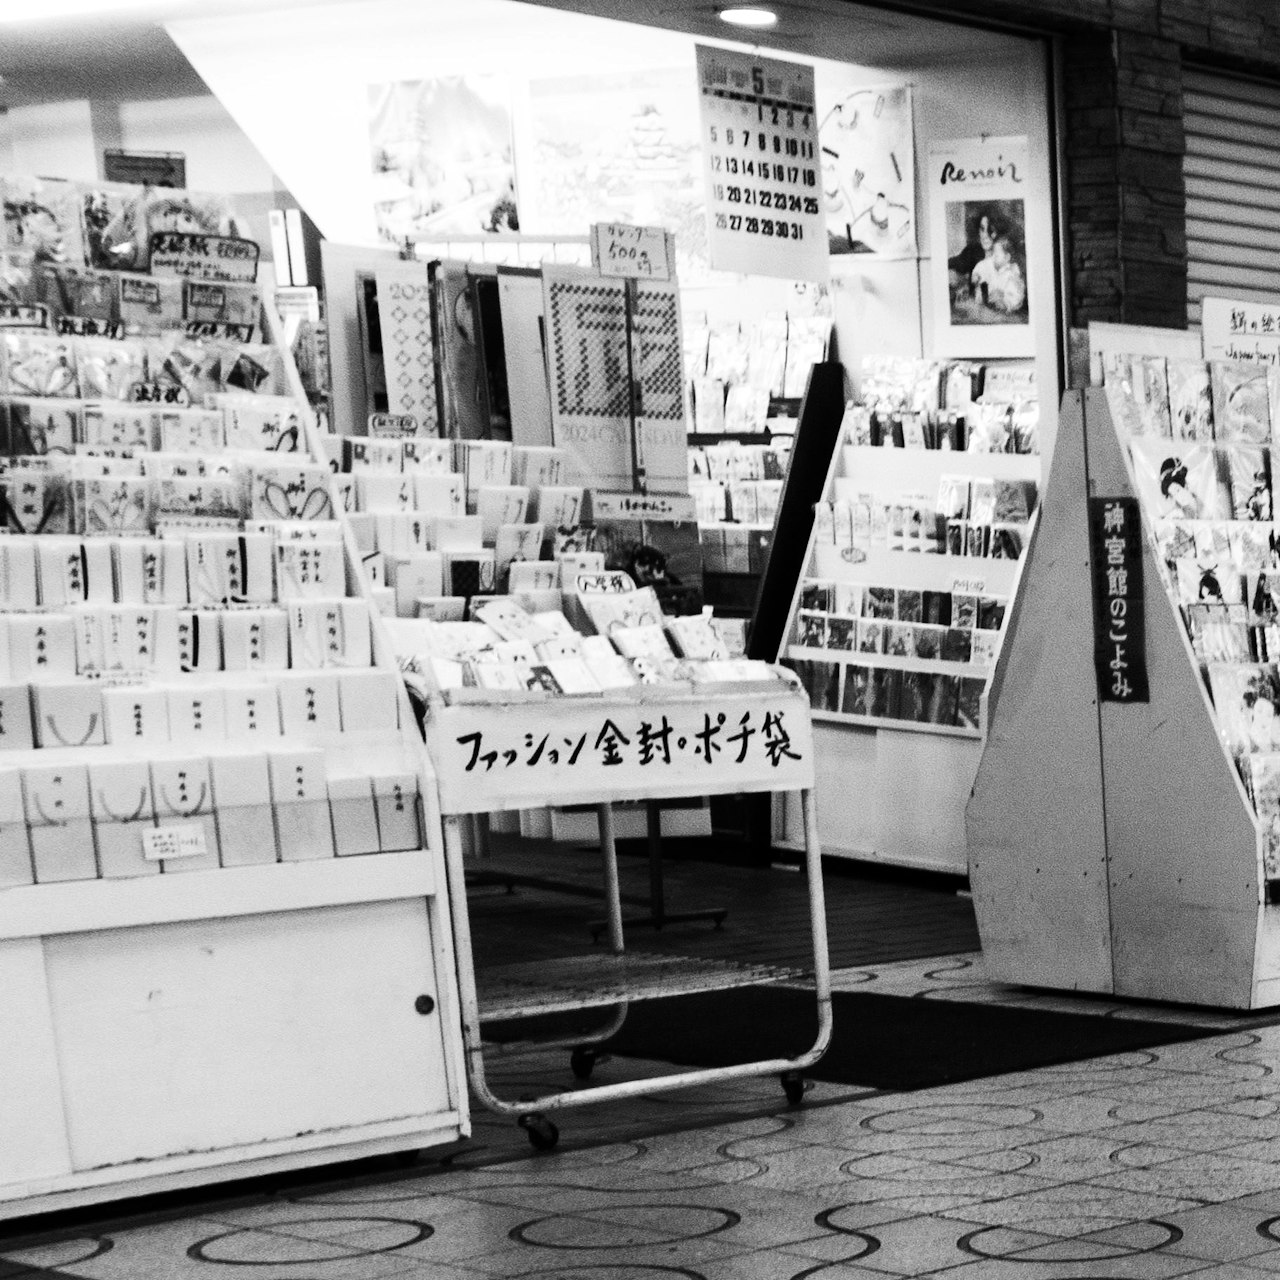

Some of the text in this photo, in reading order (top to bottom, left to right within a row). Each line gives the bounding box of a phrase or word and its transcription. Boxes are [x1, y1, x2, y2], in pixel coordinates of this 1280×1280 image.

[752, 67, 764, 94] 5
[772, 107, 779, 125] 2
[743, 130, 750, 148] 7
[786, 138, 798, 157] 10
[801, 139, 814, 159] 11
[726, 157, 738, 174] 13
[742, 159, 754, 177] 14
[758, 162, 770, 180] 15
[772, 164, 784, 182] 16
[787, 166, 799, 184] 17
[802, 169, 815, 187] 18
[940, 154, 1022, 185] Renoir
[727, 186, 740, 203] 20
[744, 188, 757, 205] 21
[759, 190, 772, 208] 22
[774, 192, 787, 211] 23
[789, 195, 802, 212] 24
[804, 197, 819, 215] 25
[729, 215, 742, 231] 27
[746, 217, 759, 234] 28
[761, 219, 774, 236] 29
[776, 222, 789, 239] 30
[791, 224, 803, 240] 31
[1104, 502, 1132, 697] 神宮館のこよみ
